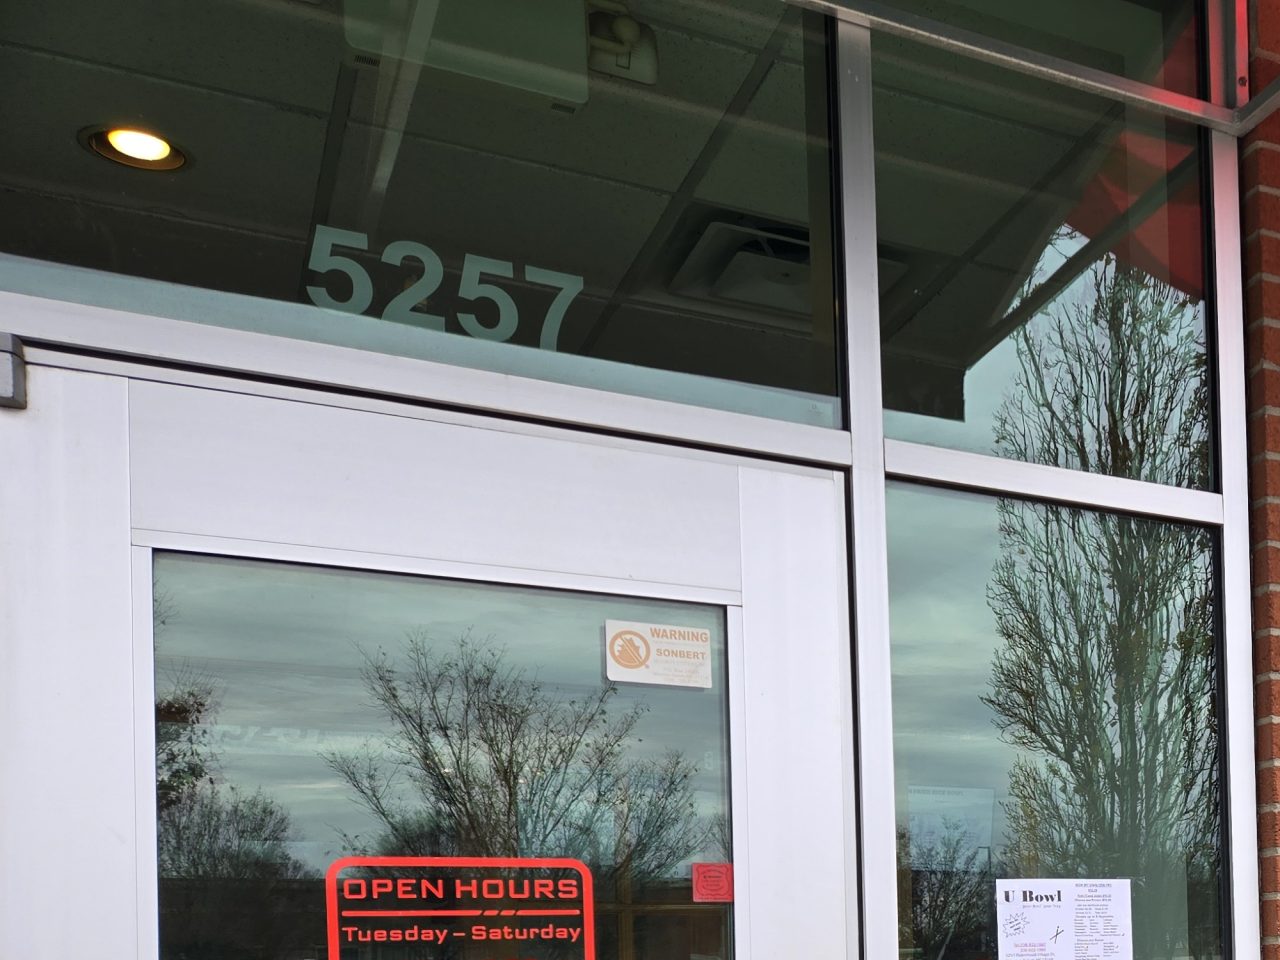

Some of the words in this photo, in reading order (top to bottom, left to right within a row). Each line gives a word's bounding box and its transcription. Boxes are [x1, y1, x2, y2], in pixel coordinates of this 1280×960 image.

[306, 224, 584, 352] 5257
[650, 627, 709, 643] WARNING
[656, 648, 706, 660] SONBERT
[343, 879, 445, 900] OPEN
[455, 878, 579, 899] HOURS
[1003, 890, 1015, 903] U
[1022, 890, 1062, 903] Bowl
[341, 926, 448, 945] Tuesday
[471, 924, 581, 943] Saturday
